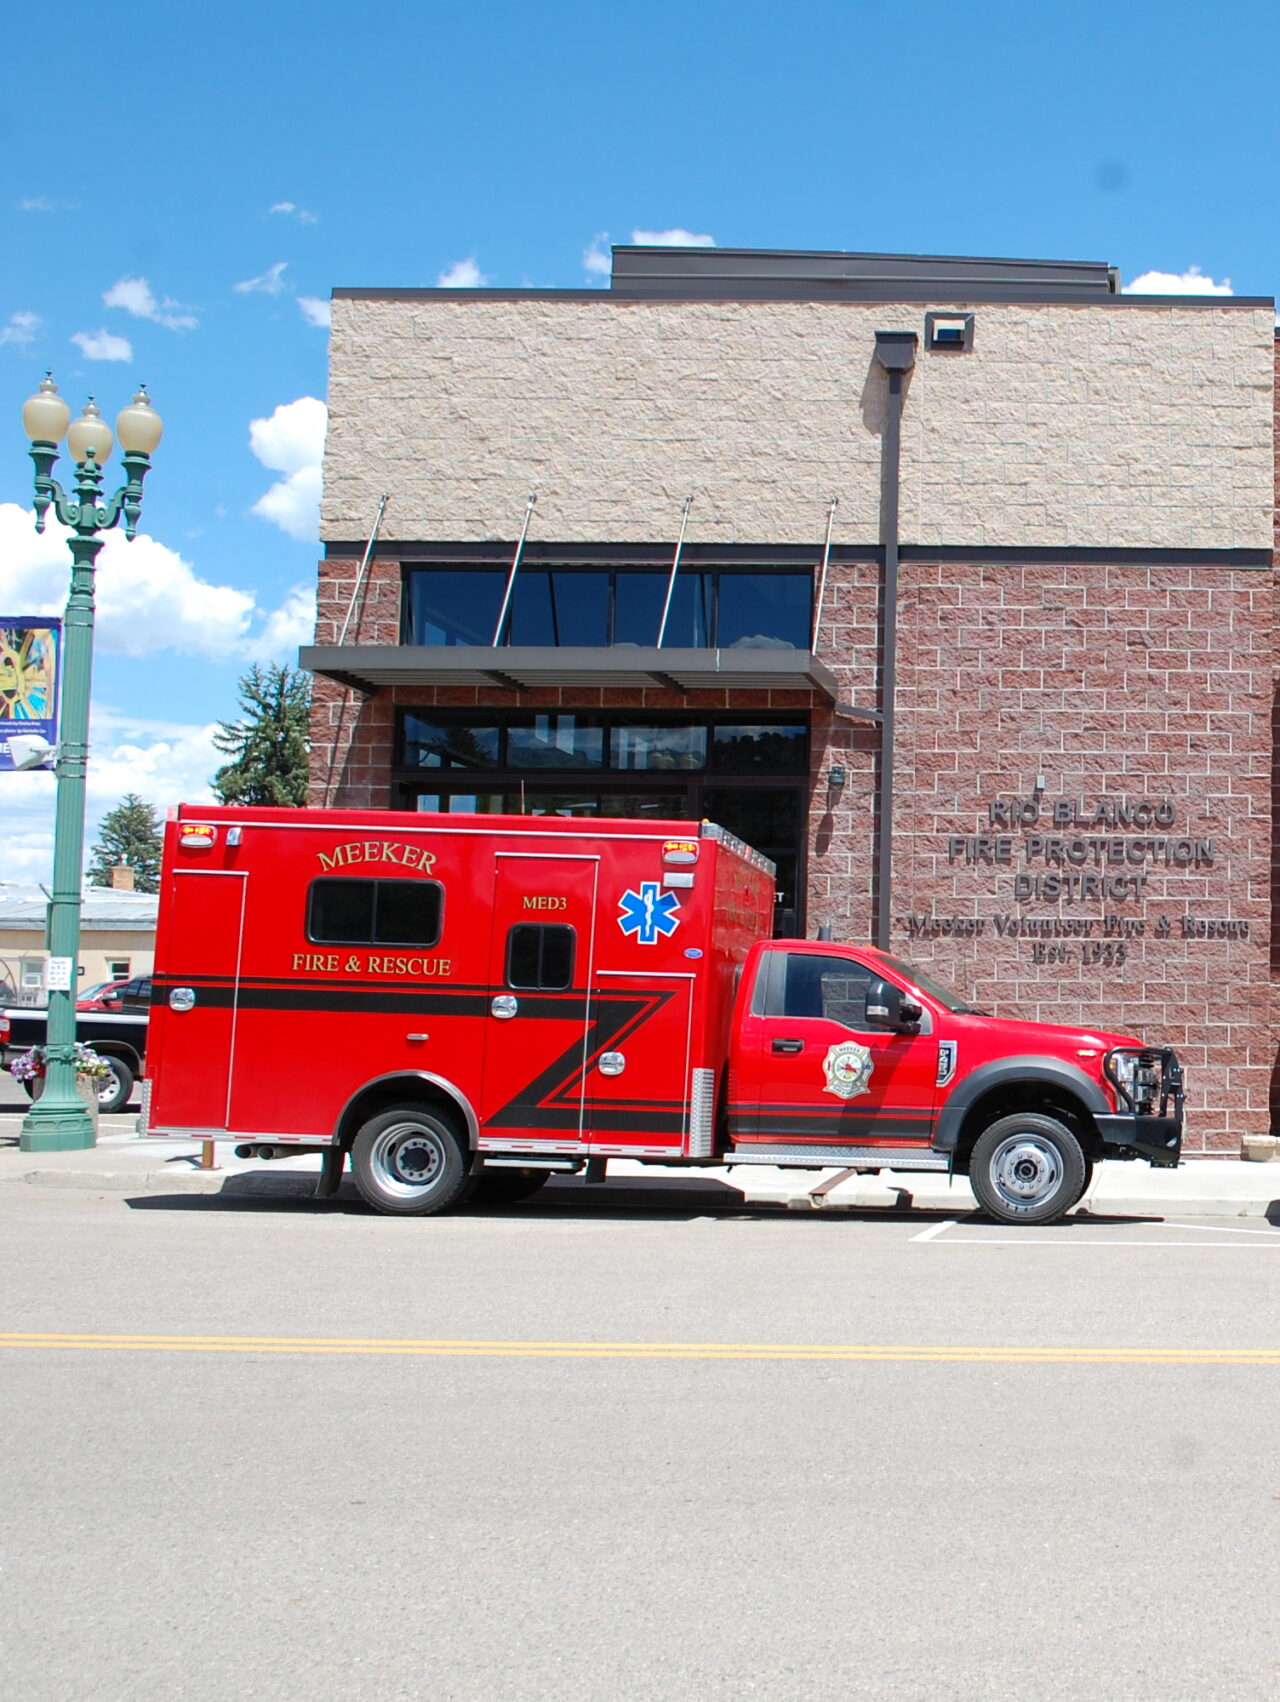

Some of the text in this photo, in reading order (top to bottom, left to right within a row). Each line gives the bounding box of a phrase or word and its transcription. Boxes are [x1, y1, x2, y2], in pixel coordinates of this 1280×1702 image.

[988, 799, 1178, 825] RIO BLANCO
[316, 841, 437, 876] MEEKER
[949, 835, 1215, 862] FIRE PROTECTION
[1014, 872, 1148, 899] DISTRICT
[522, 896, 567, 910] MED3
[908, 912, 1250, 932] Meeker Volunteer Fire & Rescue
[291, 953, 452, 976] FIRE & RESCUE
